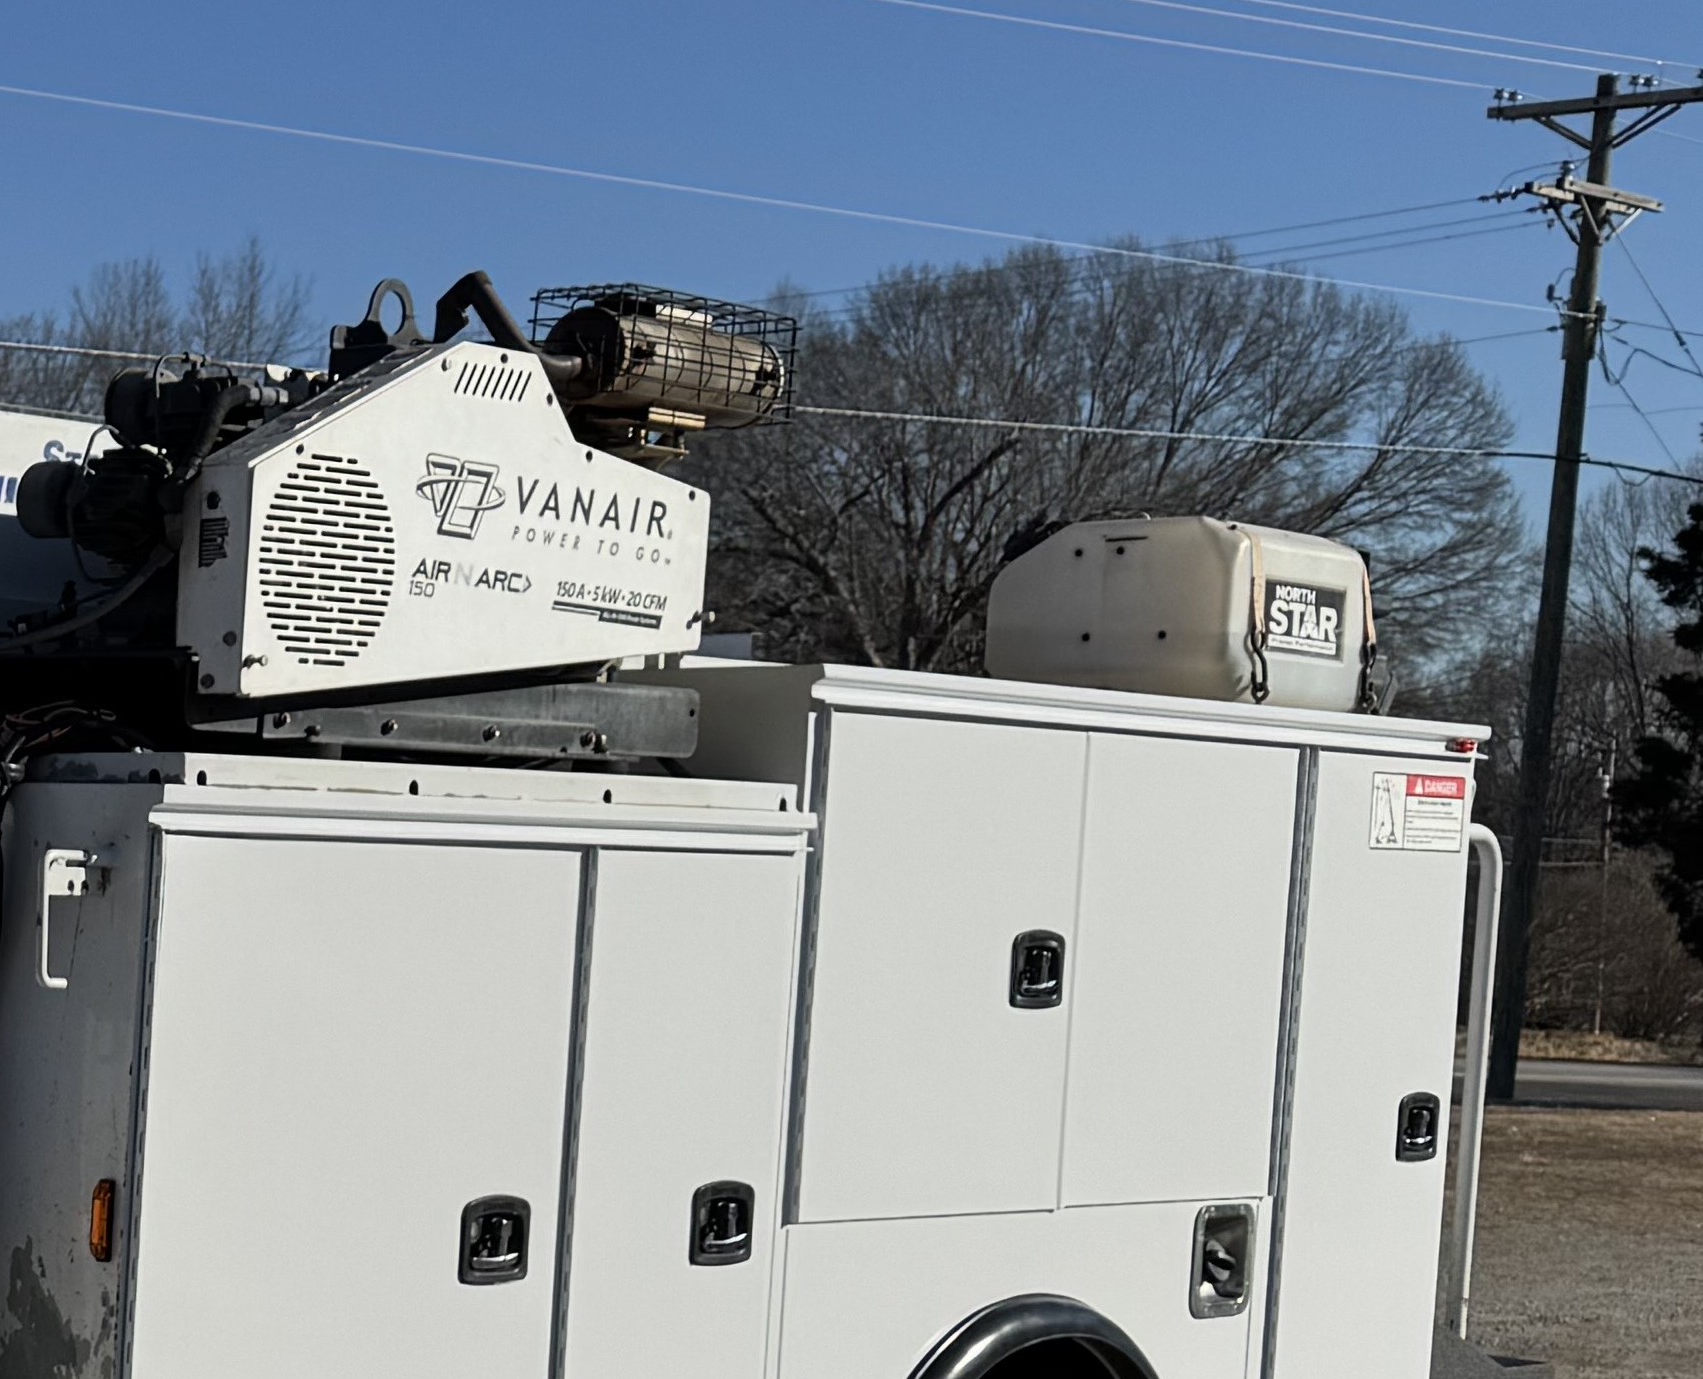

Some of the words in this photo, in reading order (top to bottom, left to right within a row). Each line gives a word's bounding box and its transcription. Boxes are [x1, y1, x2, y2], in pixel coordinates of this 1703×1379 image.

[517, 475, 668, 538] VANAIR
[512, 525, 581, 550] POWER
[597, 540, 620, 556] TO
[635, 546, 661, 564] GO
[412, 557, 452, 582] AIR
[409, 580, 436, 598] 150
[1275, 584, 1316, 604] NORTH
[1269, 599, 1338, 642] STAR
